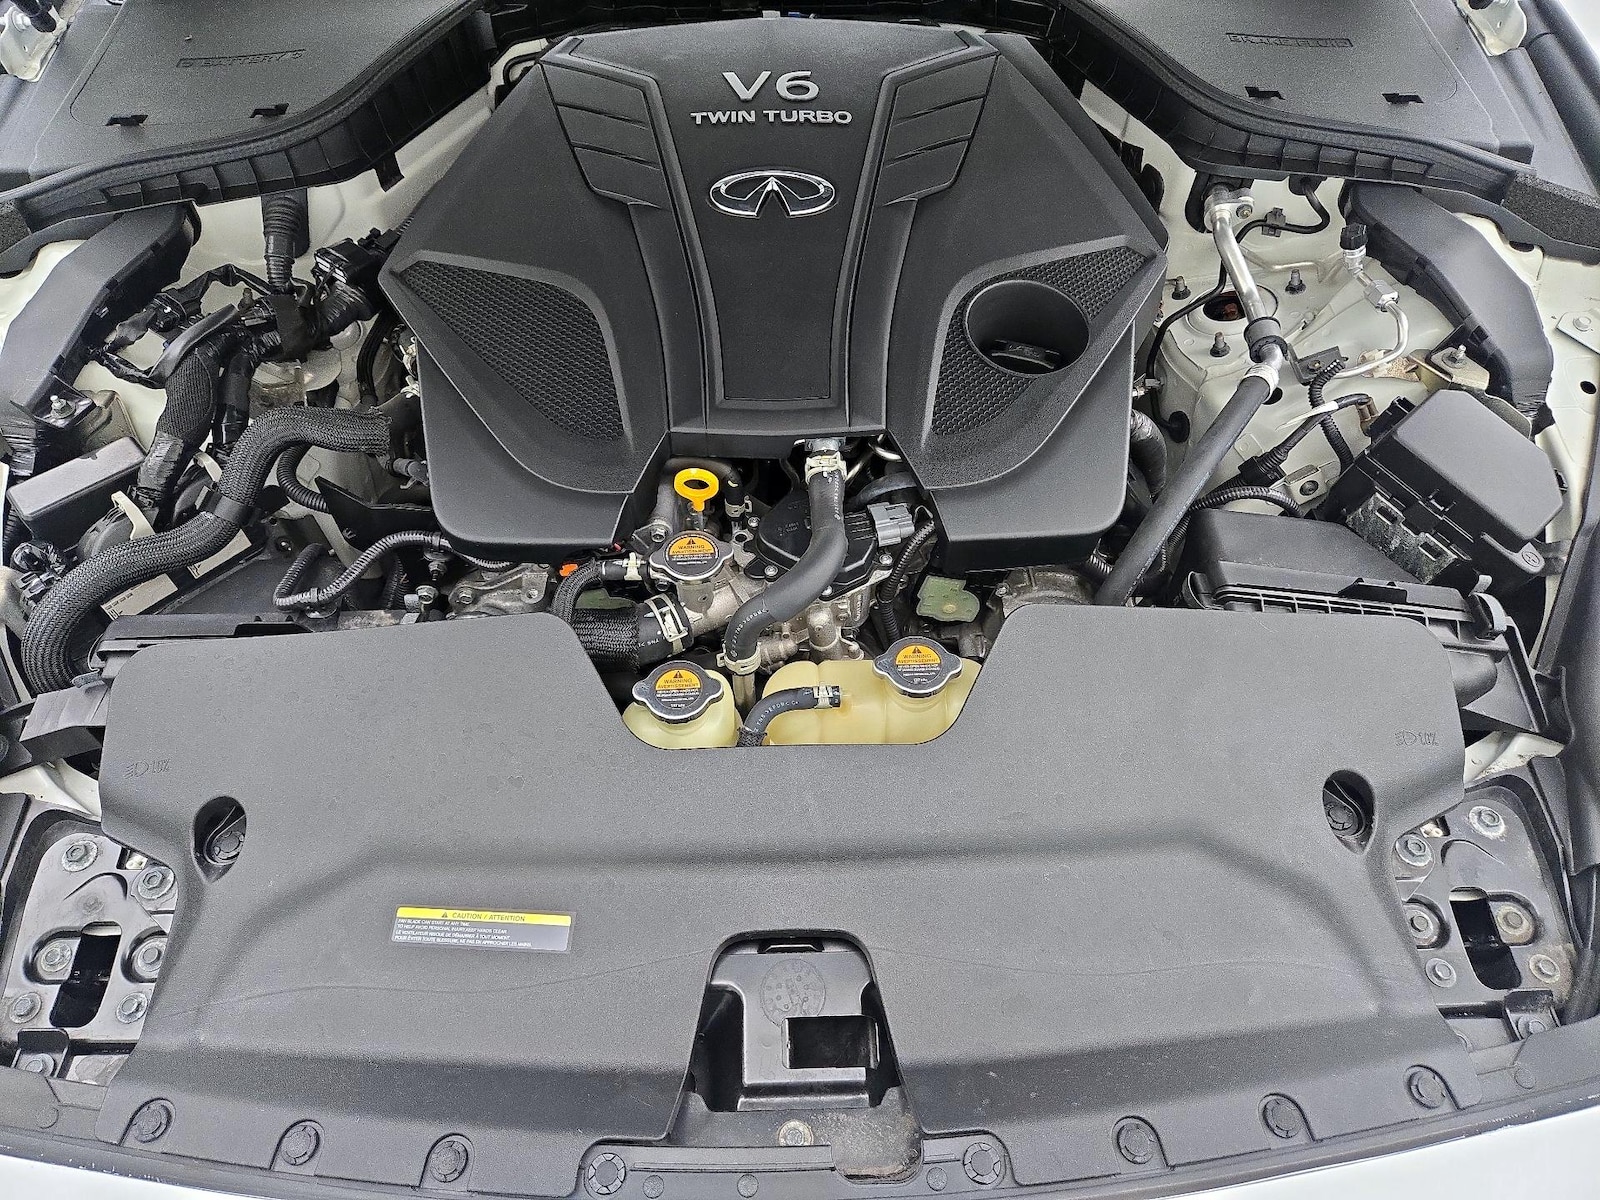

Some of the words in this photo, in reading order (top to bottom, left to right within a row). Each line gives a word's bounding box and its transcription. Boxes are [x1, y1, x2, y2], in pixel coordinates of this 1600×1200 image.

[722, 71, 819, 101] V6
[690, 110, 756, 125] TWIN
[763, 110, 852, 125] TURBO
[452, 912, 483, 920] CAUTION
[489, 914, 526, 922] ATTENTION
